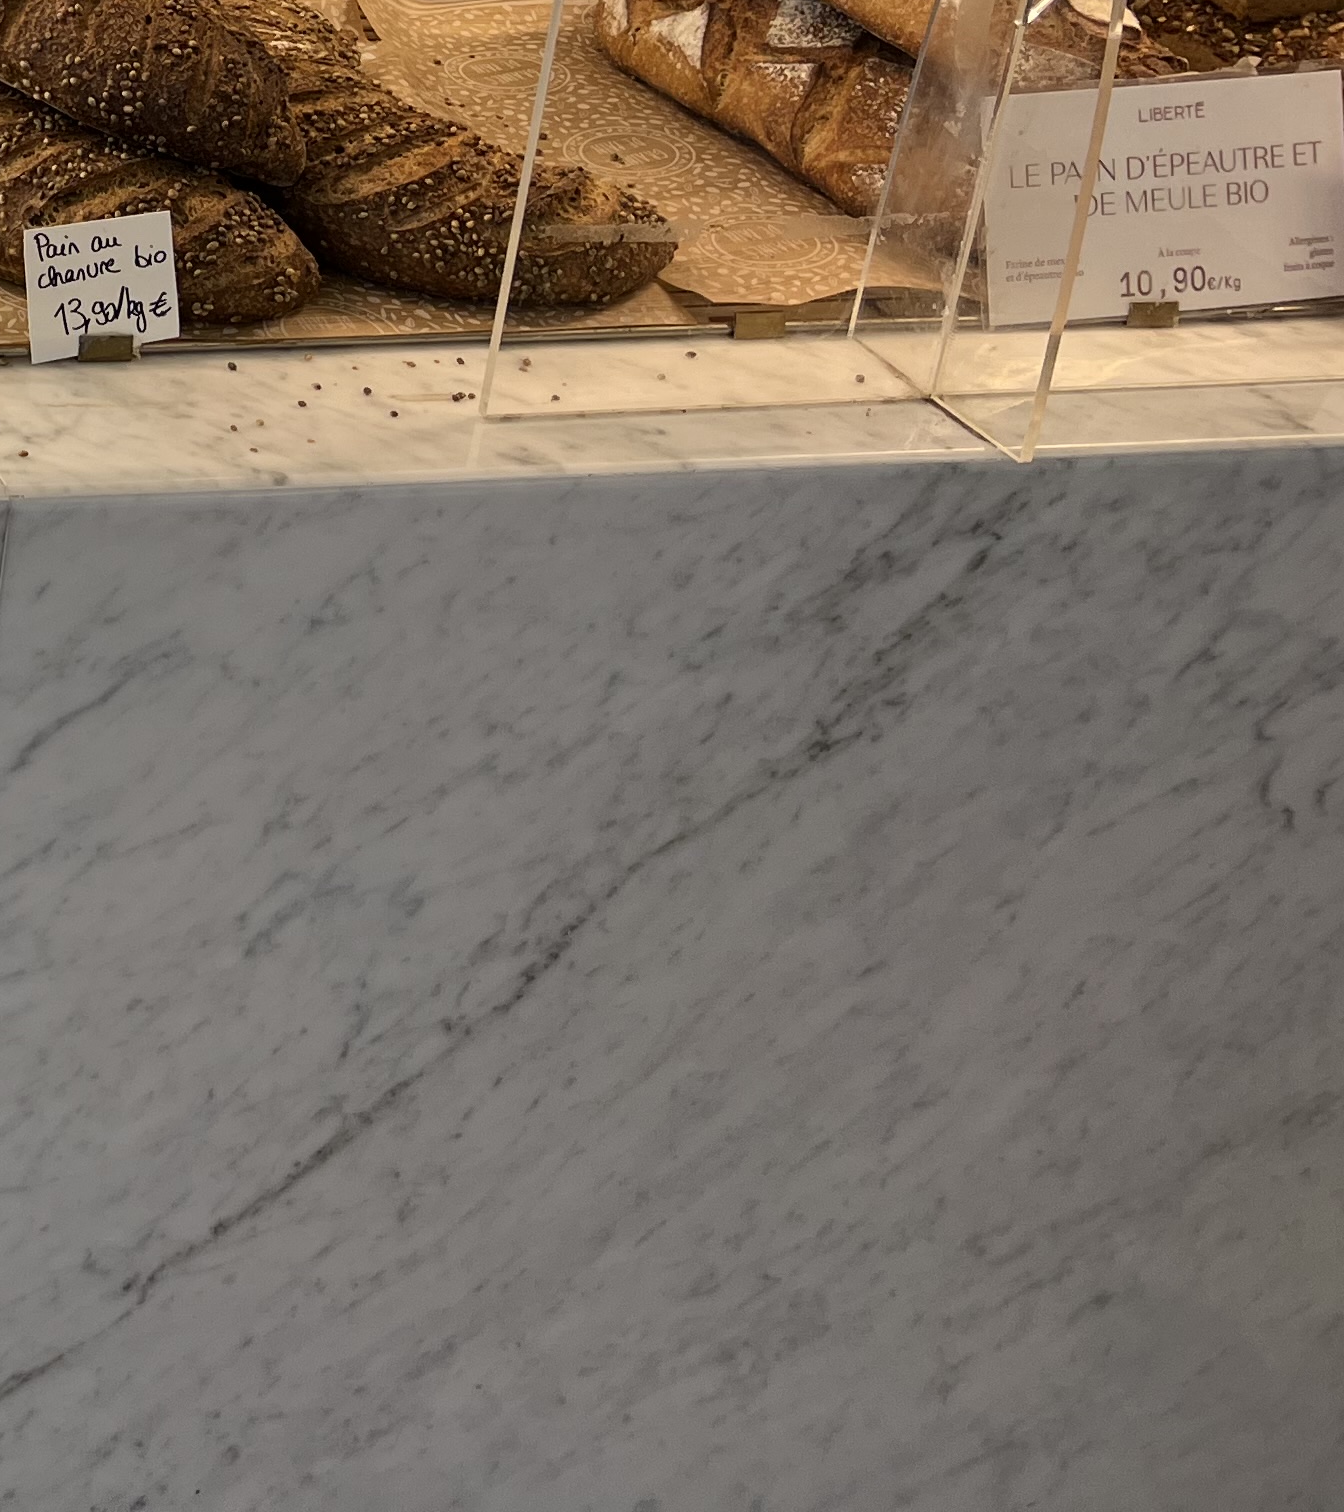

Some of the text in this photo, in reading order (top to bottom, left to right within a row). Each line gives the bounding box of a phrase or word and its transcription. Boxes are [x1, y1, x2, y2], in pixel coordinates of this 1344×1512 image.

[1138, 101, 1206, 123] LIBERTÉ
[1009, 163, 1042, 189] LE
[1050, 157, 1116, 185] PAN
[1293, 140, 1322, 167] ET
[1125, 184, 1218, 215] MEULE
[1226, 180, 1269, 206] BIO
[33, 233, 122, 262] Pain au
[134, 244, 167, 268] bio
[1120, 265, 1241, 299] 10,90€/Kg
